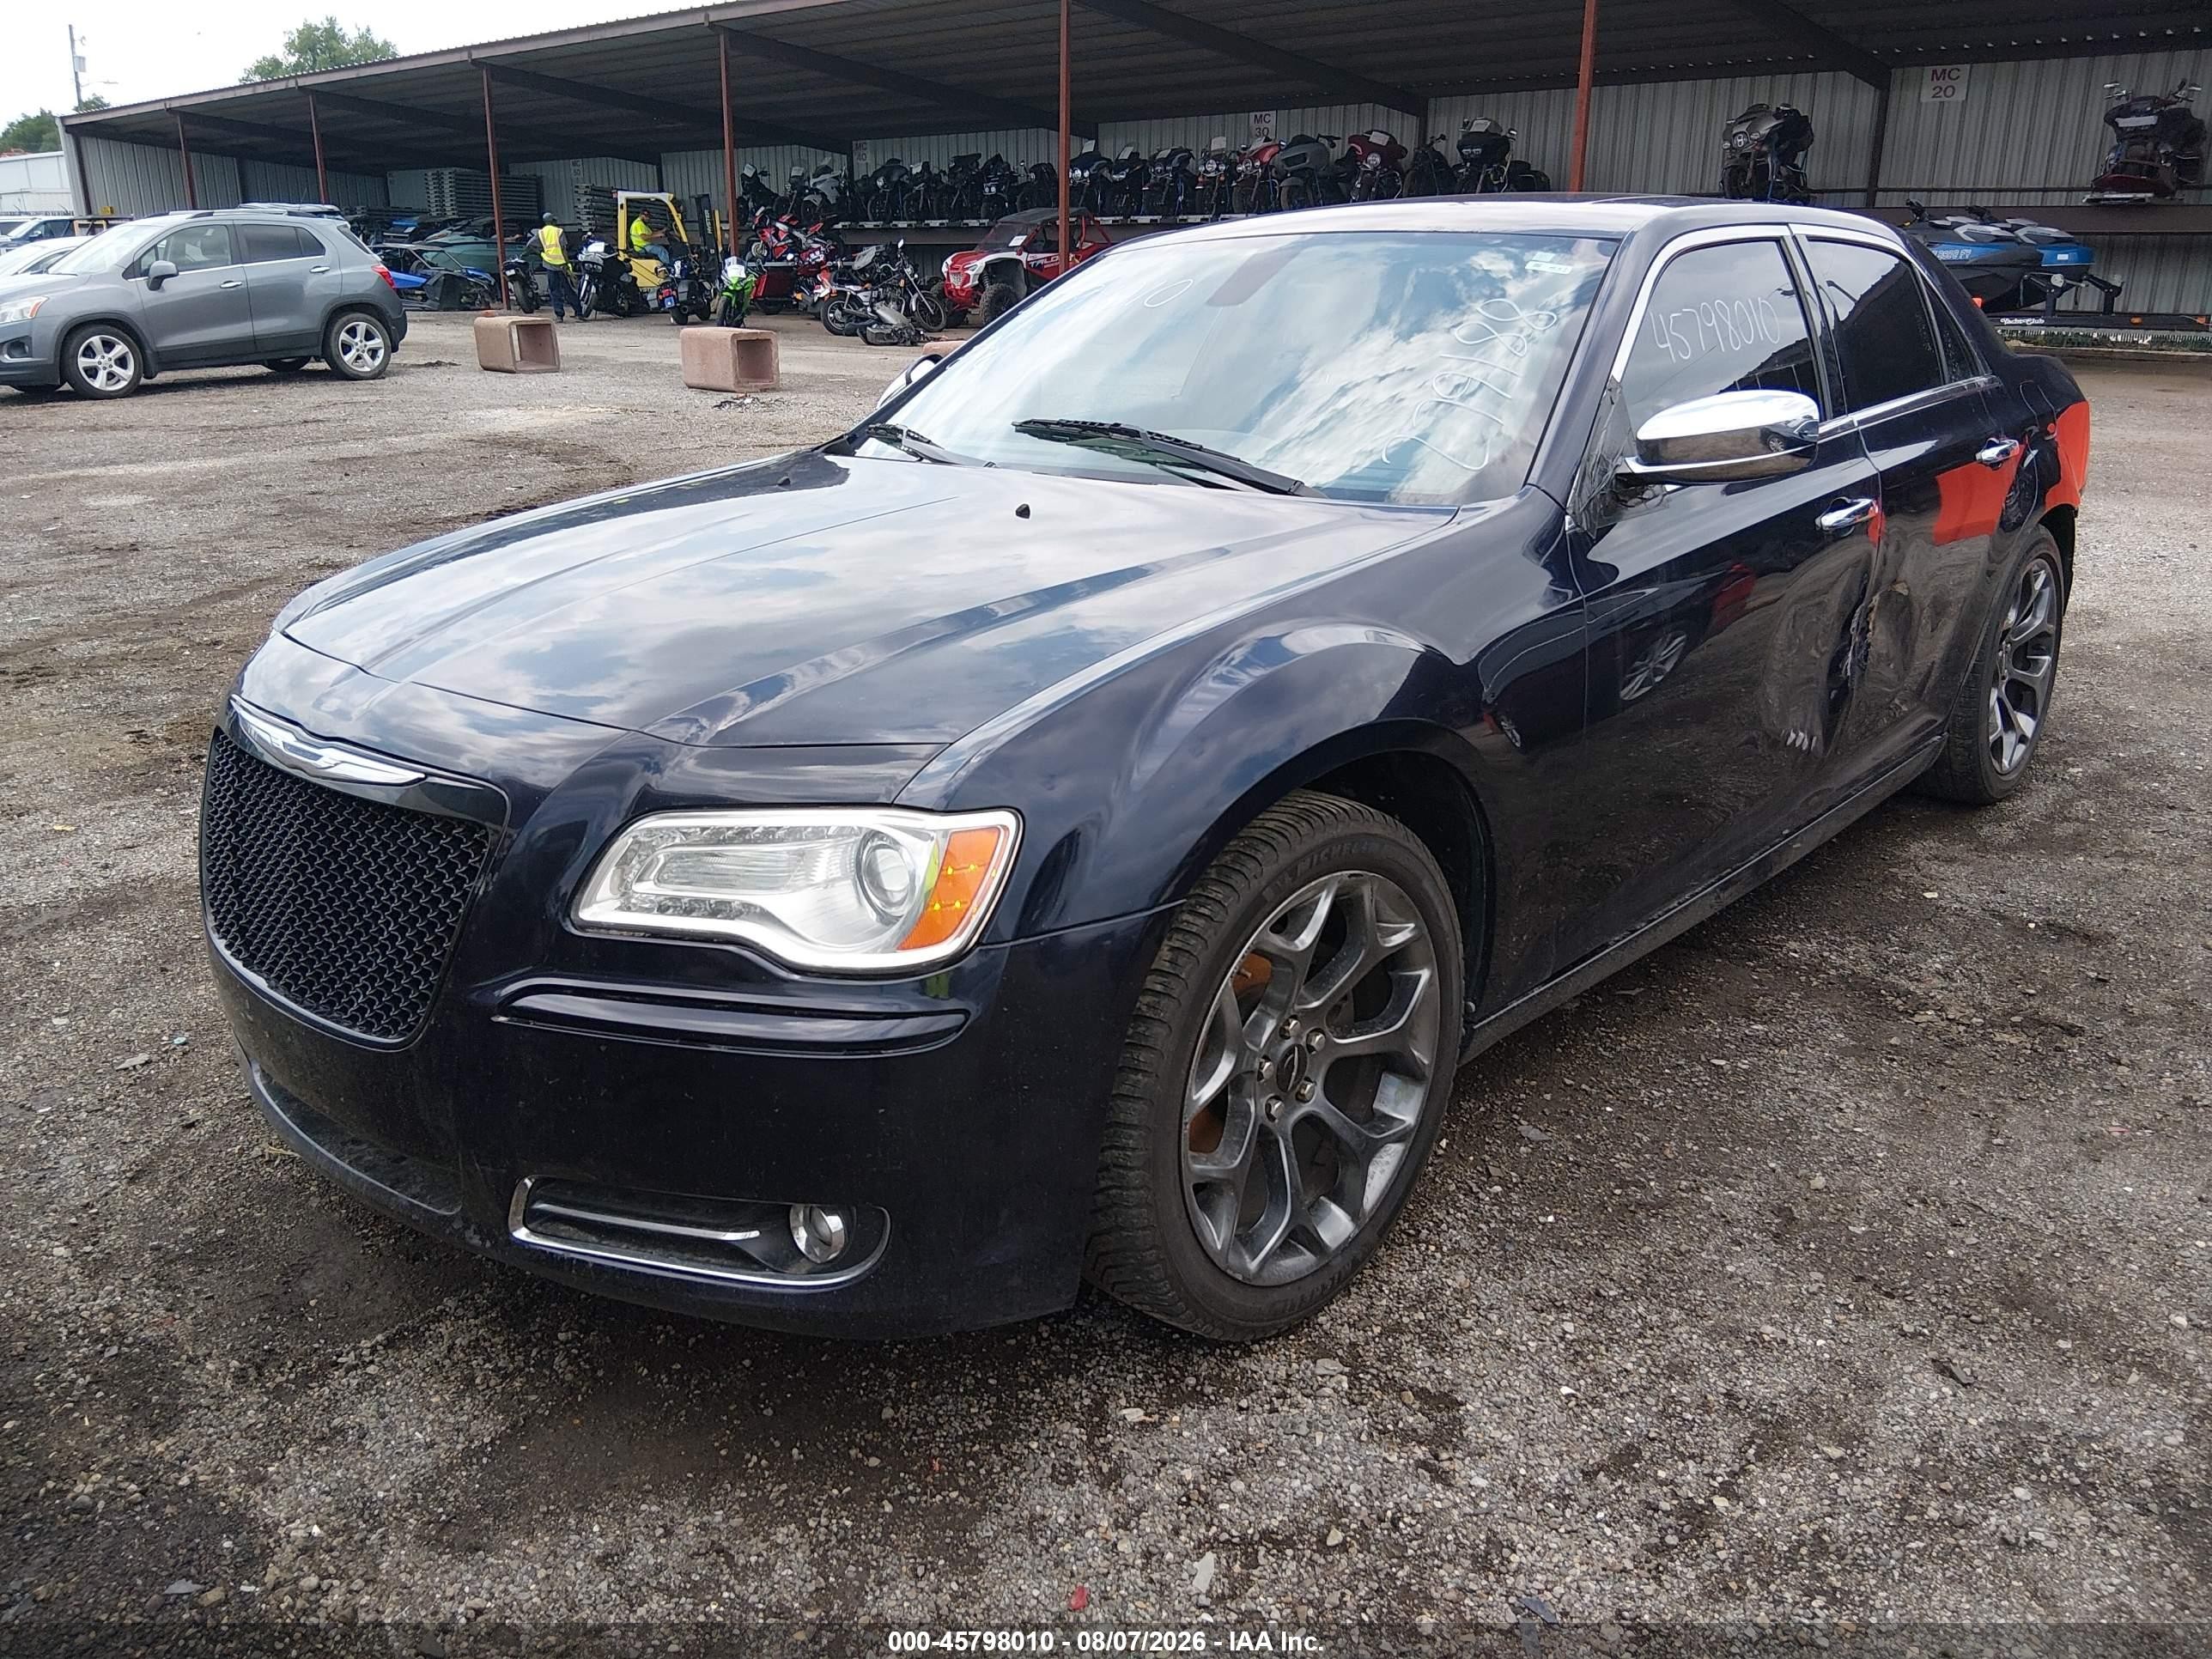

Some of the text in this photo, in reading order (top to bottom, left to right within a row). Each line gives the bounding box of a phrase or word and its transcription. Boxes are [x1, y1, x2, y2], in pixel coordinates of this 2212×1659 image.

[1930, 67, 1961, 82] MC
[1930, 84, 1956, 99] 20
[1254, 112, 1272, 125] MC
[1255, 126, 1270, 137] 30
[854, 141, 867, 151] MC
[1649, 296, 1780, 363] 45798010
